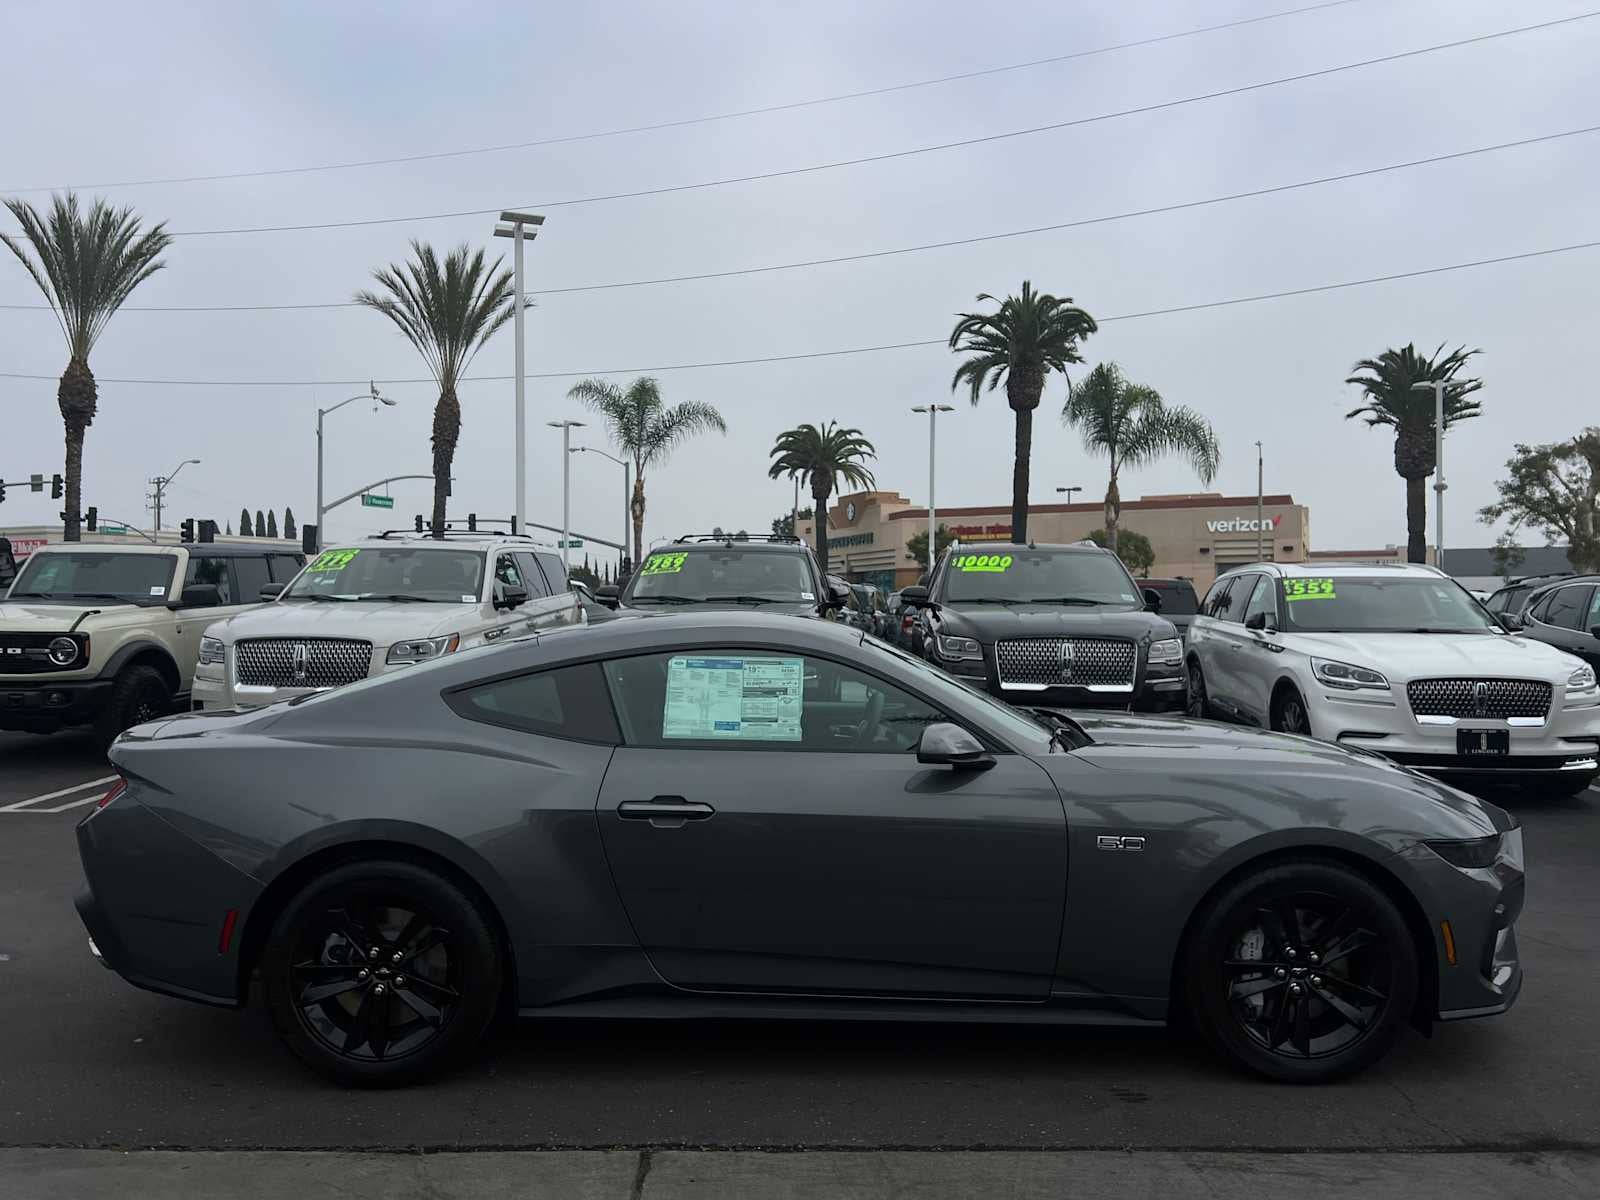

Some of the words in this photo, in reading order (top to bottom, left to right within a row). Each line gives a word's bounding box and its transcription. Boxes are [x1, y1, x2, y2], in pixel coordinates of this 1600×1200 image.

[1206, 516, 1274, 533] verizon
[951, 555, 1013, 568] $10000
[1097, 835, 1146, 851] 5.0
